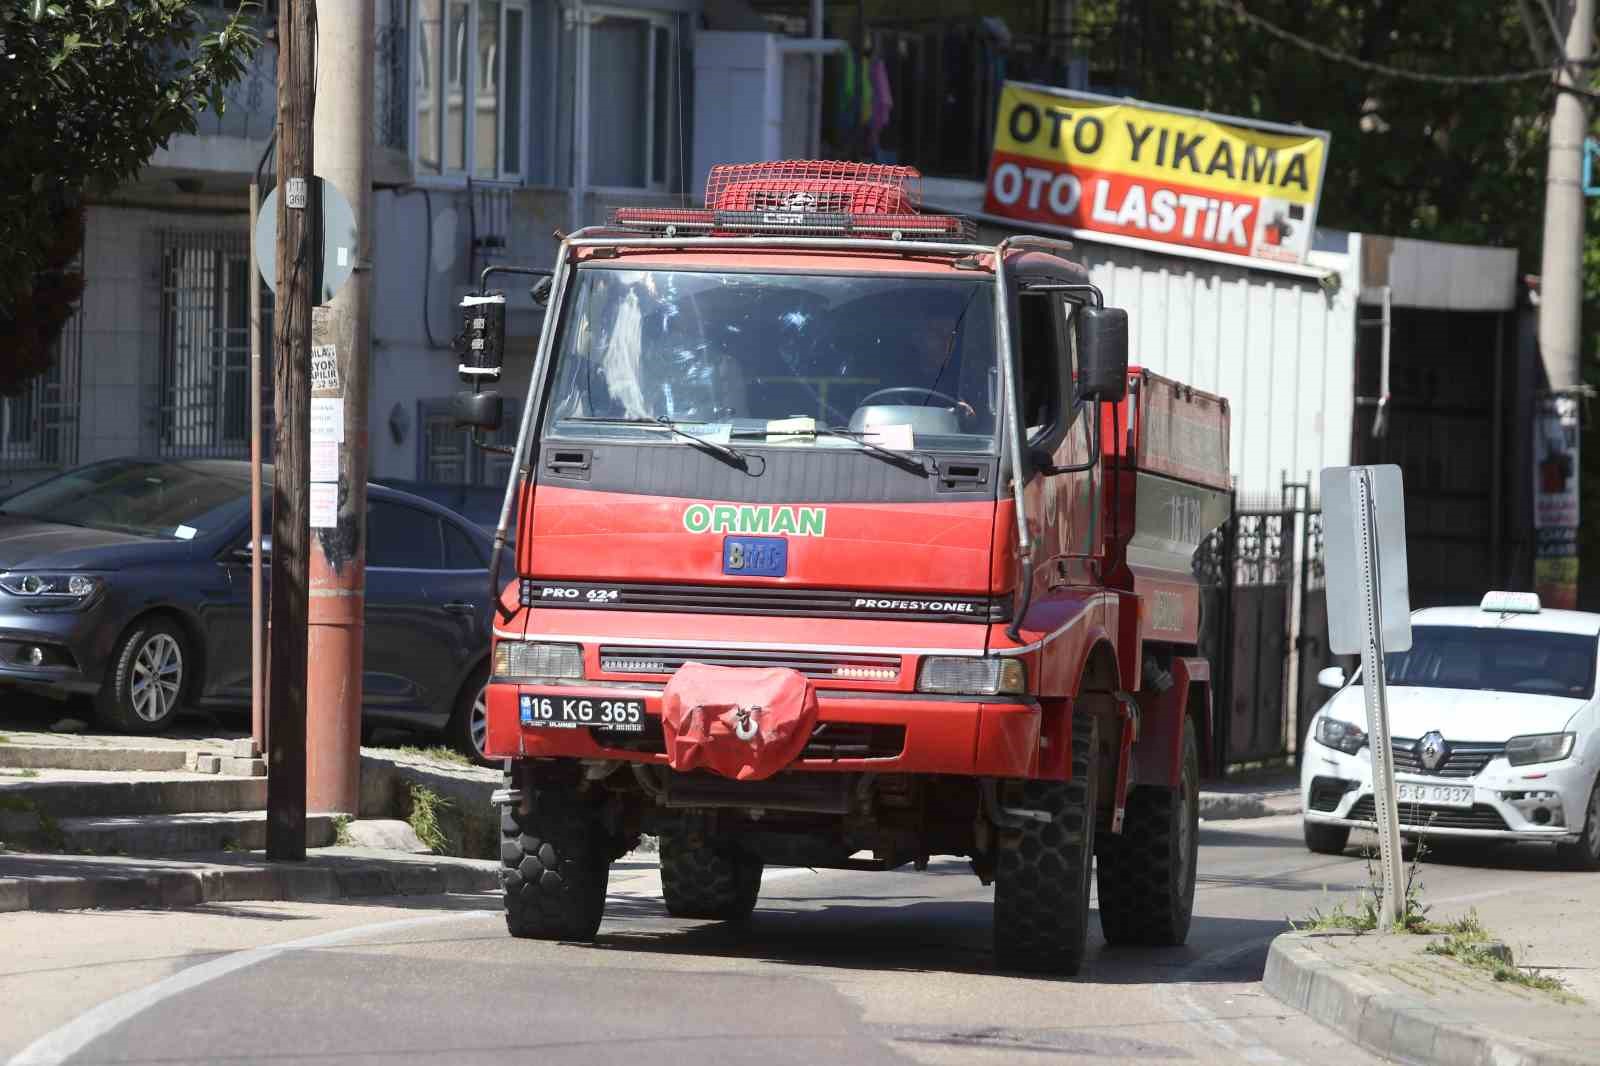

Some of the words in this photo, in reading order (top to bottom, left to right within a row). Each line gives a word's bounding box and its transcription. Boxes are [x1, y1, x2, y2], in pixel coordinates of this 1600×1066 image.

[1008, 103, 1105, 154] OTO
[1125, 121, 1309, 191] YIKAMA
[993, 163, 1082, 216] OTO
[682, 503, 827, 537] ORMAN
[541, 587, 580, 599] PRO
[585, 589, 620, 600] 624
[853, 598, 975, 613] PROFESYONEL
[531, 697, 553, 719] 16
[562, 699, 594, 721] KG
[599, 701, 641, 723] 365
